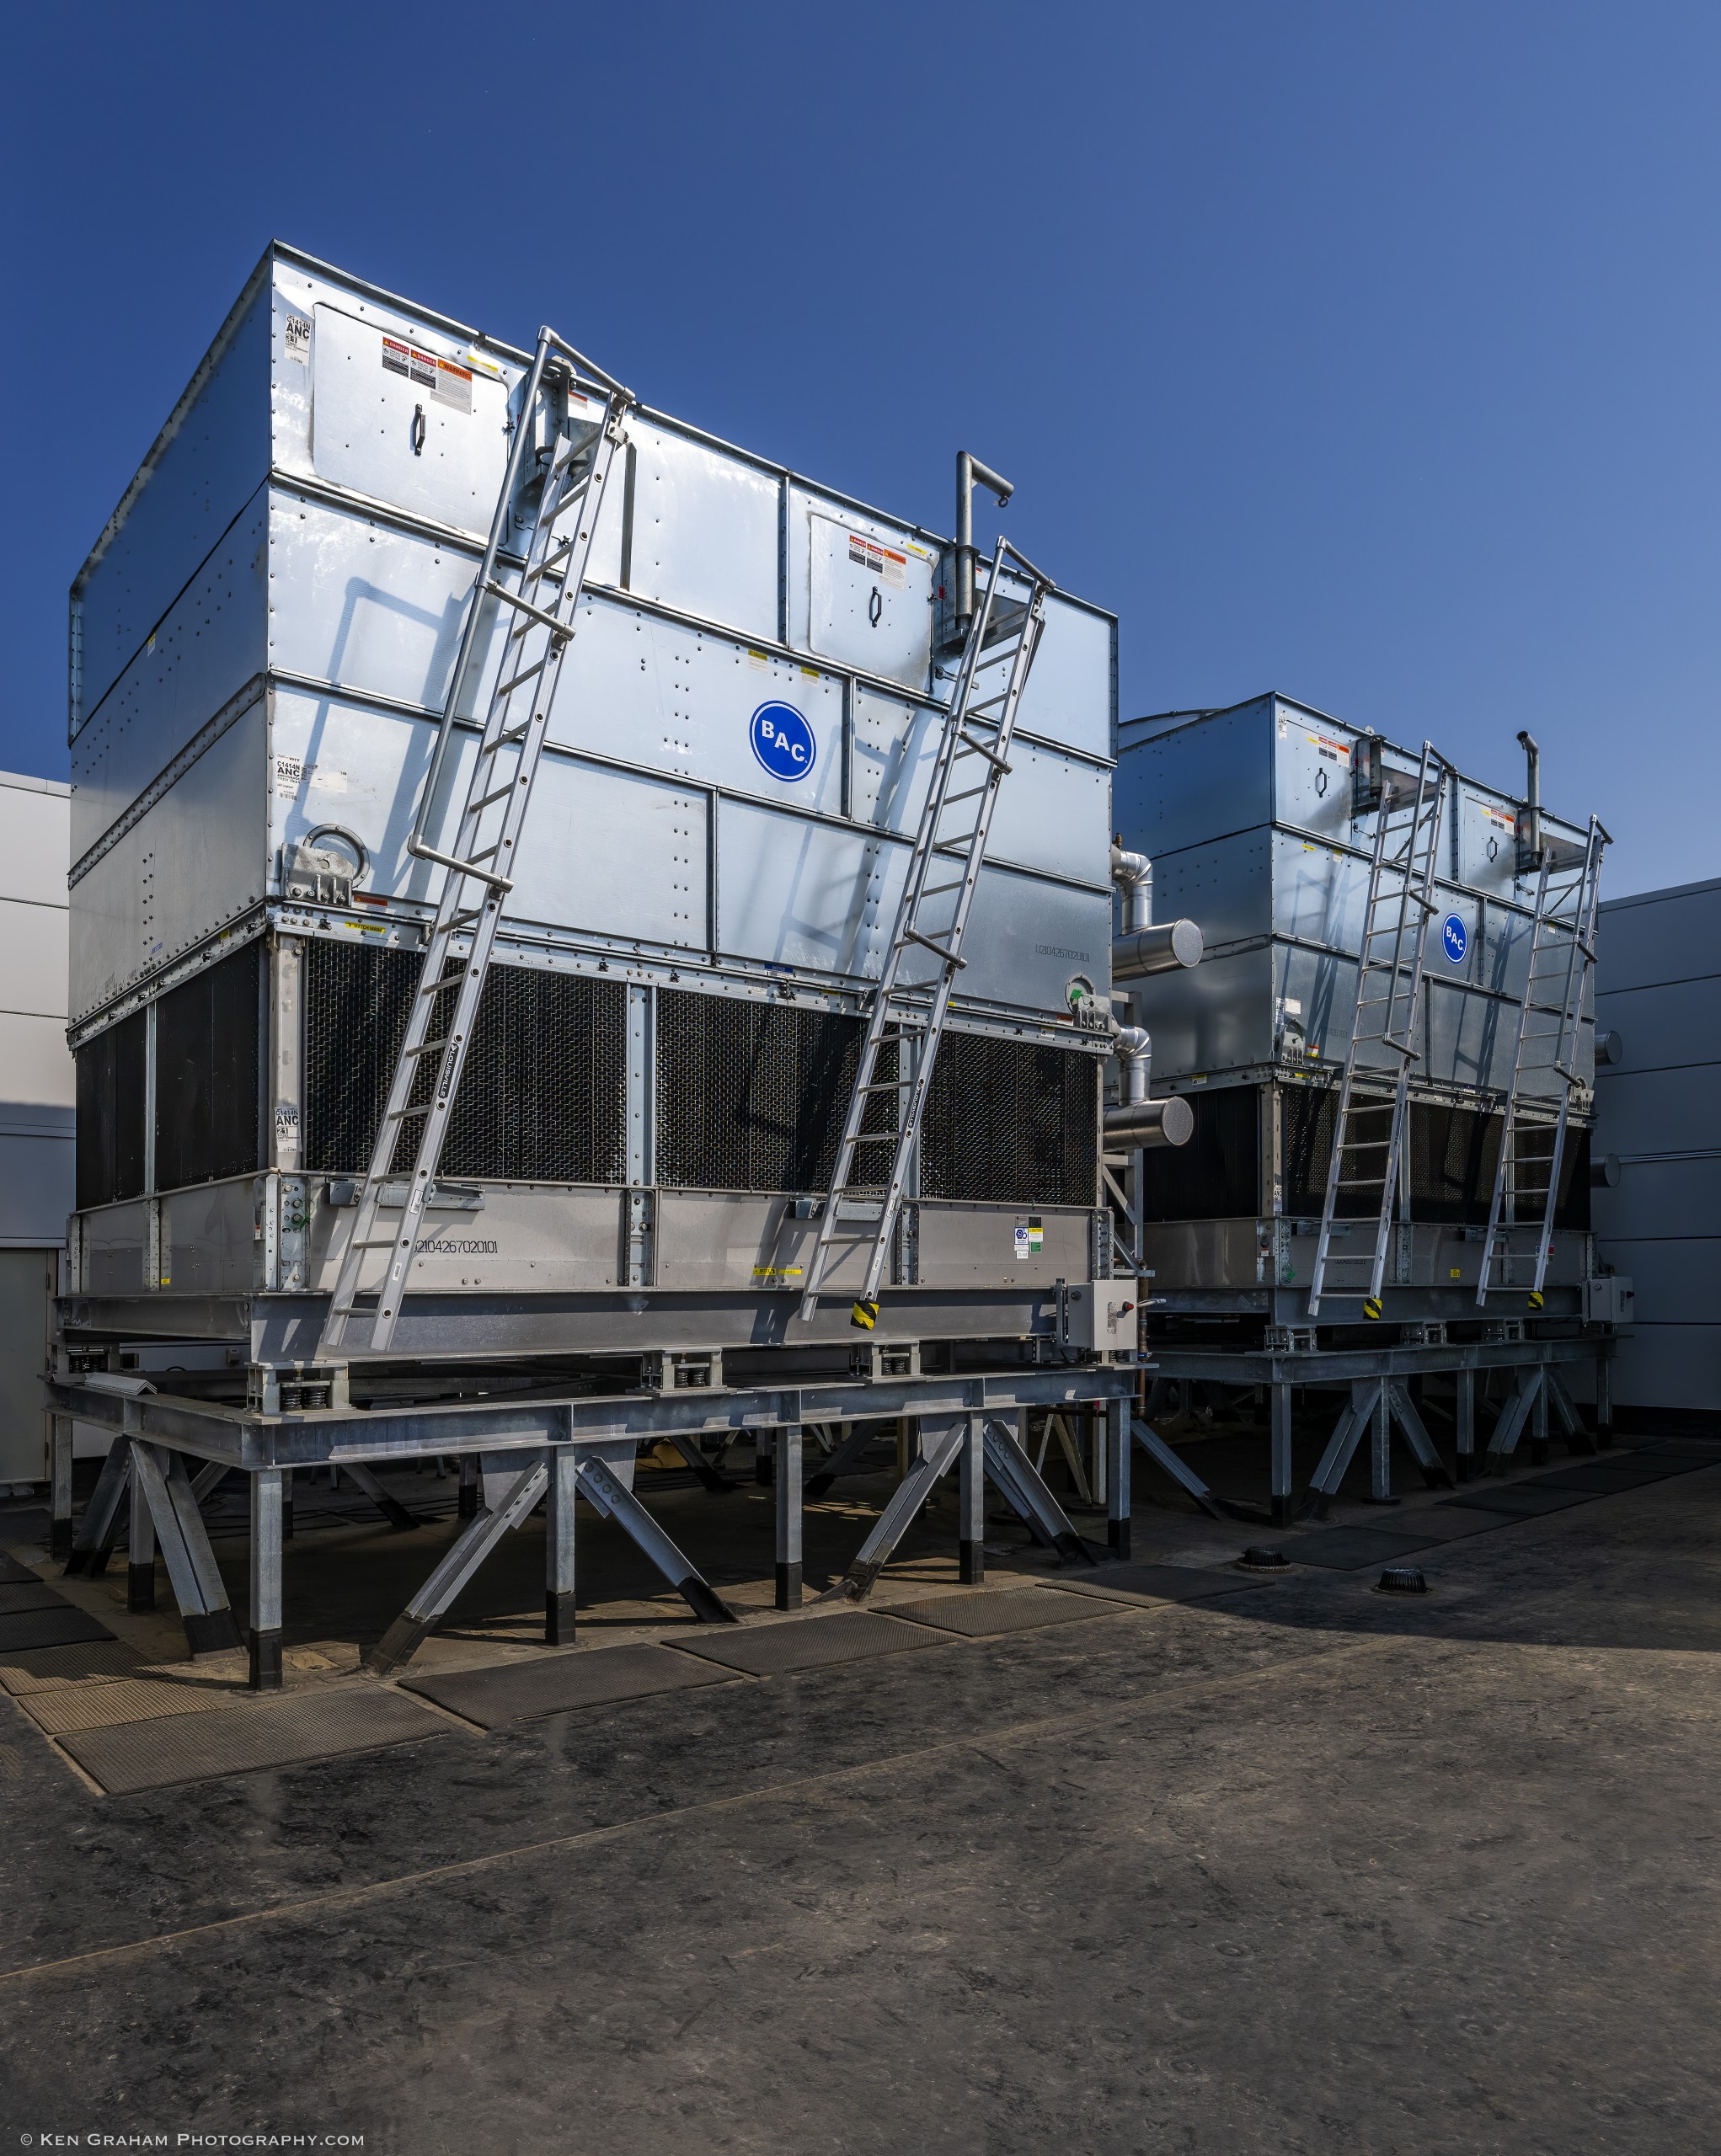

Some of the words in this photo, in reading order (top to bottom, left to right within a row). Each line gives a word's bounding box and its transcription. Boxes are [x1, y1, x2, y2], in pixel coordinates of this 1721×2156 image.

[286, 323, 310, 339] ANC
[389, 342, 409, 354] DANGER
[444, 364, 472, 379] WARNING
[762, 719, 805, 762] BAC
[277, 760, 300, 771] C1414N
[277, 766, 300, 777] ANC
[1446, 926, 1464, 951] BAC
[440, 1050, 456, 1097] LOUISVILLE
[276, 1116, 299, 1126] ANC
[414, 1240, 498, 1254] 2104267020101
